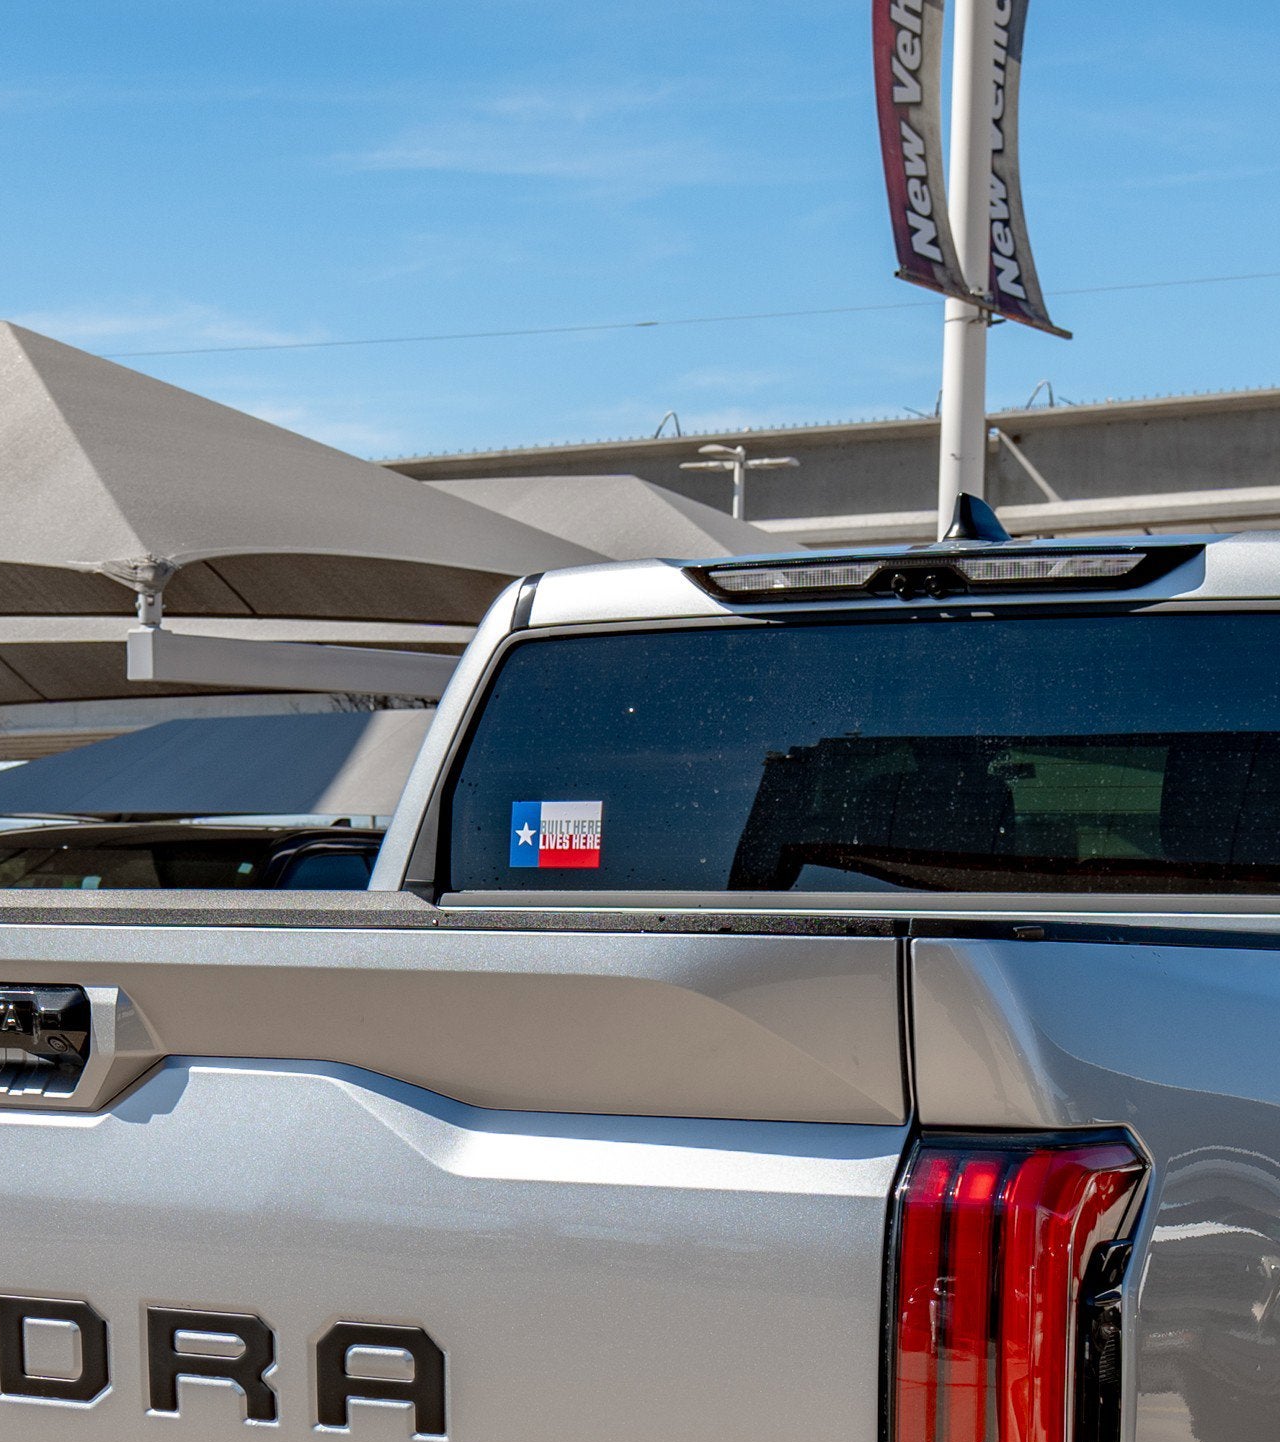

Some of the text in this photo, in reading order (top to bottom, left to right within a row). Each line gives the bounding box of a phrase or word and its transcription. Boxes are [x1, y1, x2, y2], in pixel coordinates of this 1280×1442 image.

[901, 116, 943, 263] New
[990, 170, 1028, 300] New
[539, 834, 601, 850] LIVES HERE
[541, 820, 601, 834] BUILT HERE
